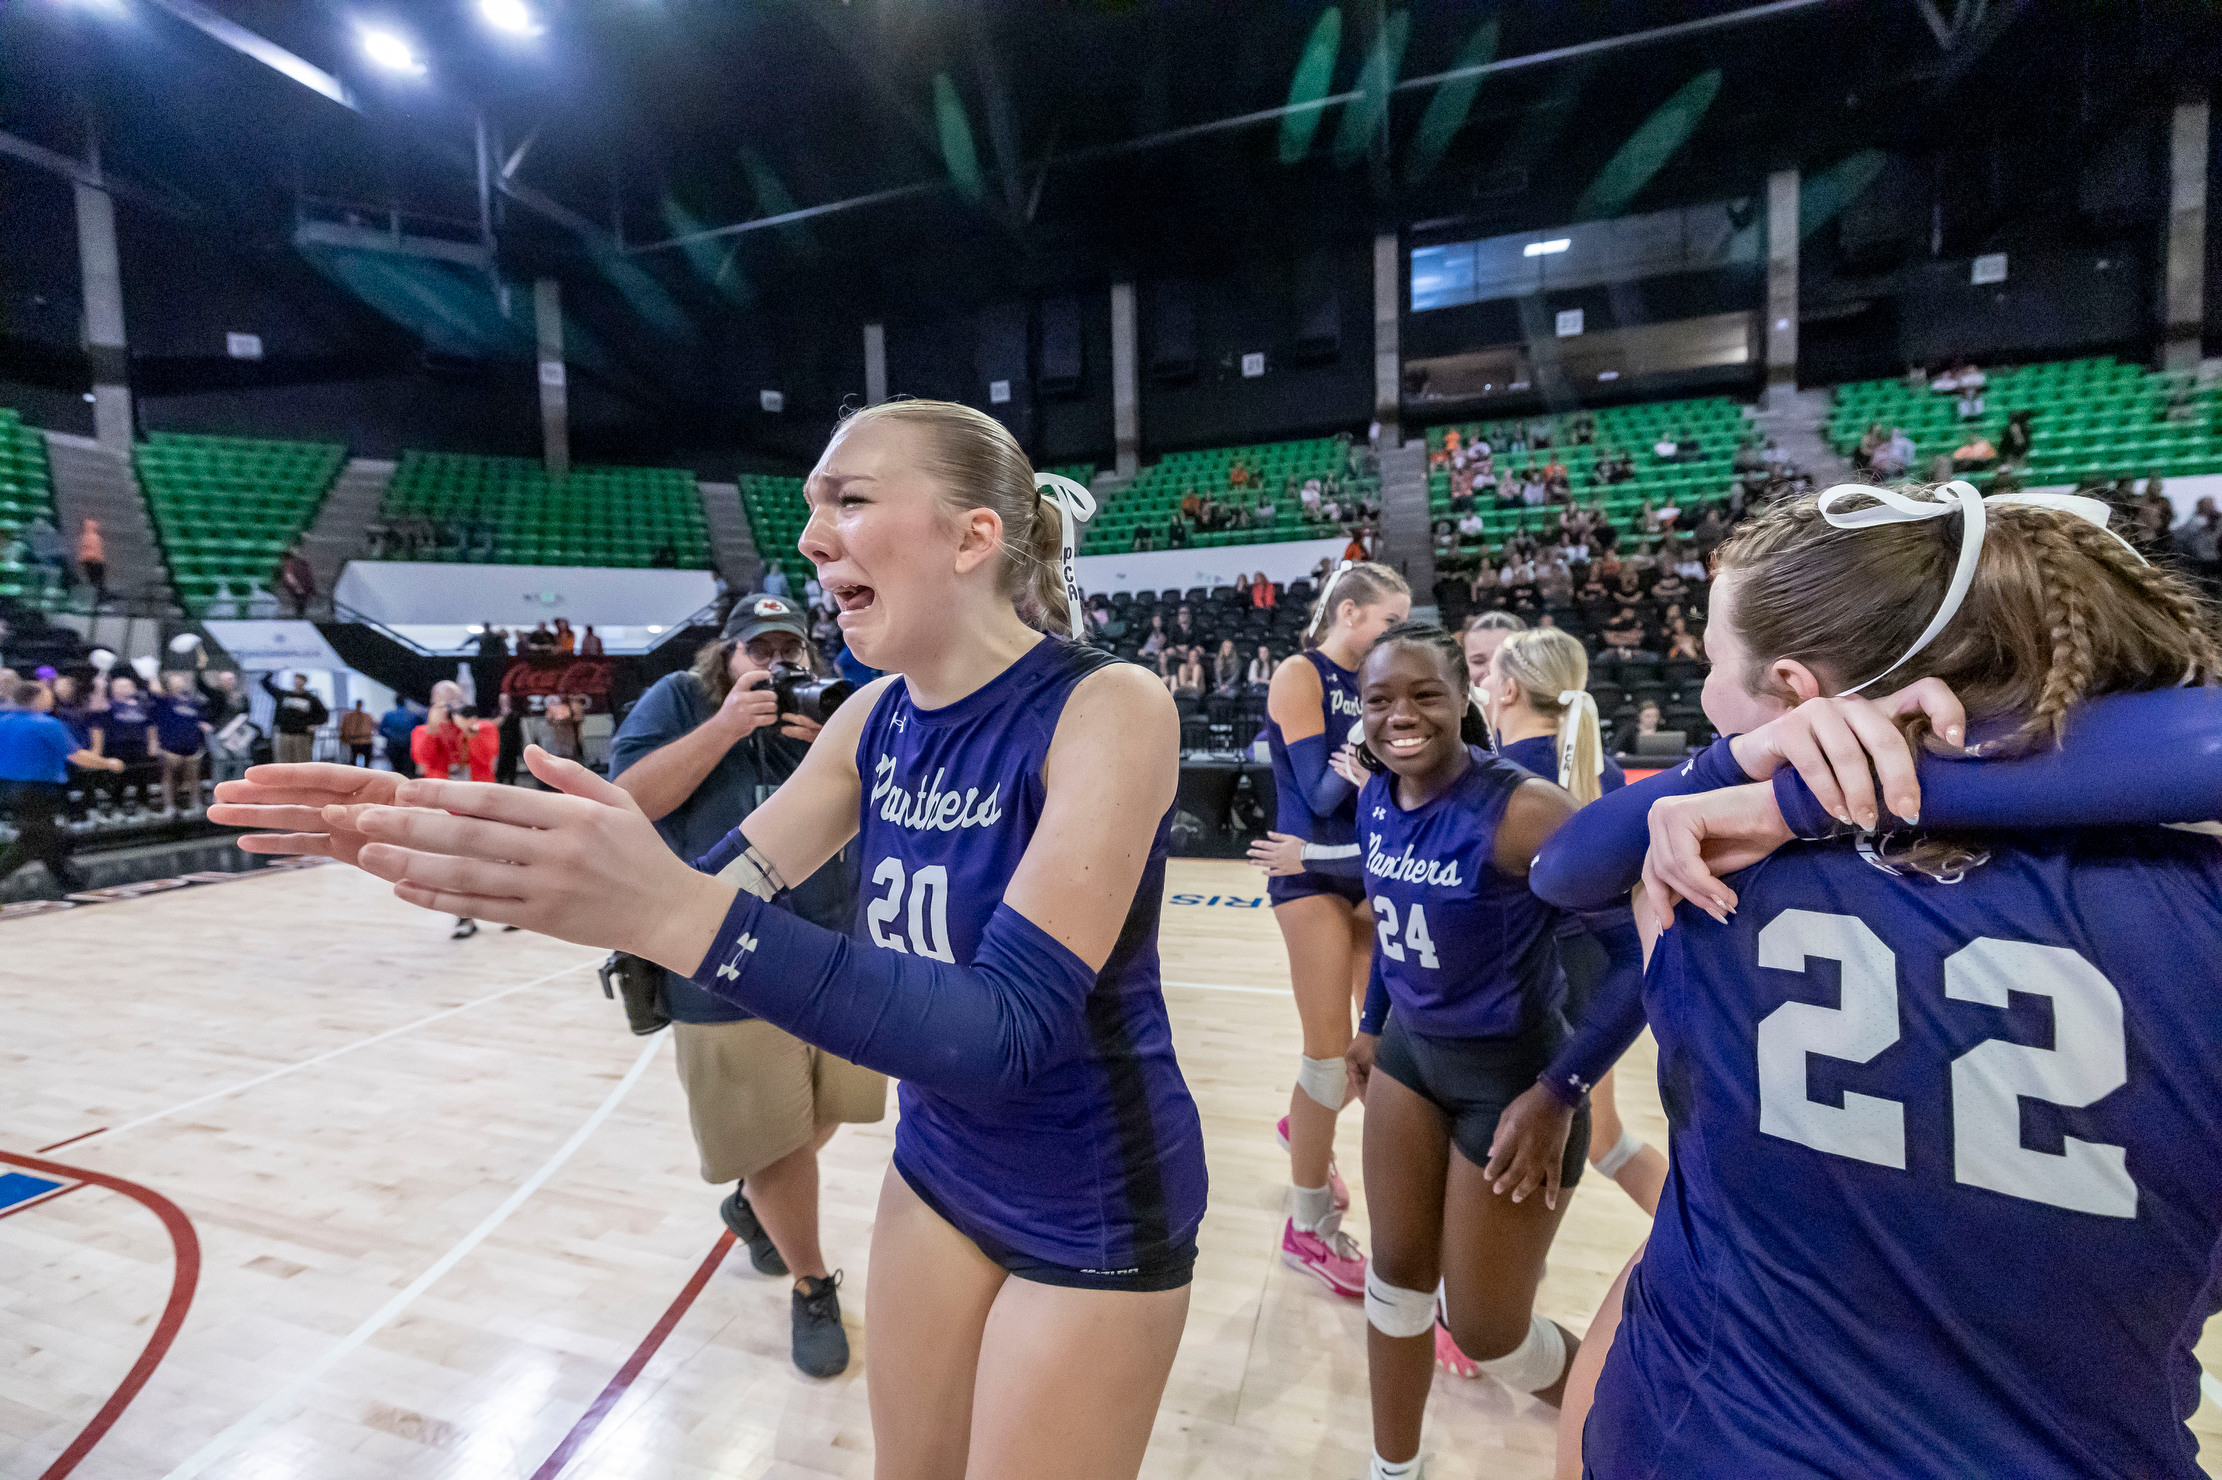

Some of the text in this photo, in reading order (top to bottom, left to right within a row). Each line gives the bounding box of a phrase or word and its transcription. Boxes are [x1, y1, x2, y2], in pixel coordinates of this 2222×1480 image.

[1063, 546, 1078, 602] PCA
[870, 753, 1002, 832] Panthers
[1366, 831, 1463, 887] Panthers
[867, 856, 956, 965] 20
[1167, 893, 1273, 908] RIS
[1373, 894, 1441, 969] 24
[1757, 907, 2138, 1219] 22
